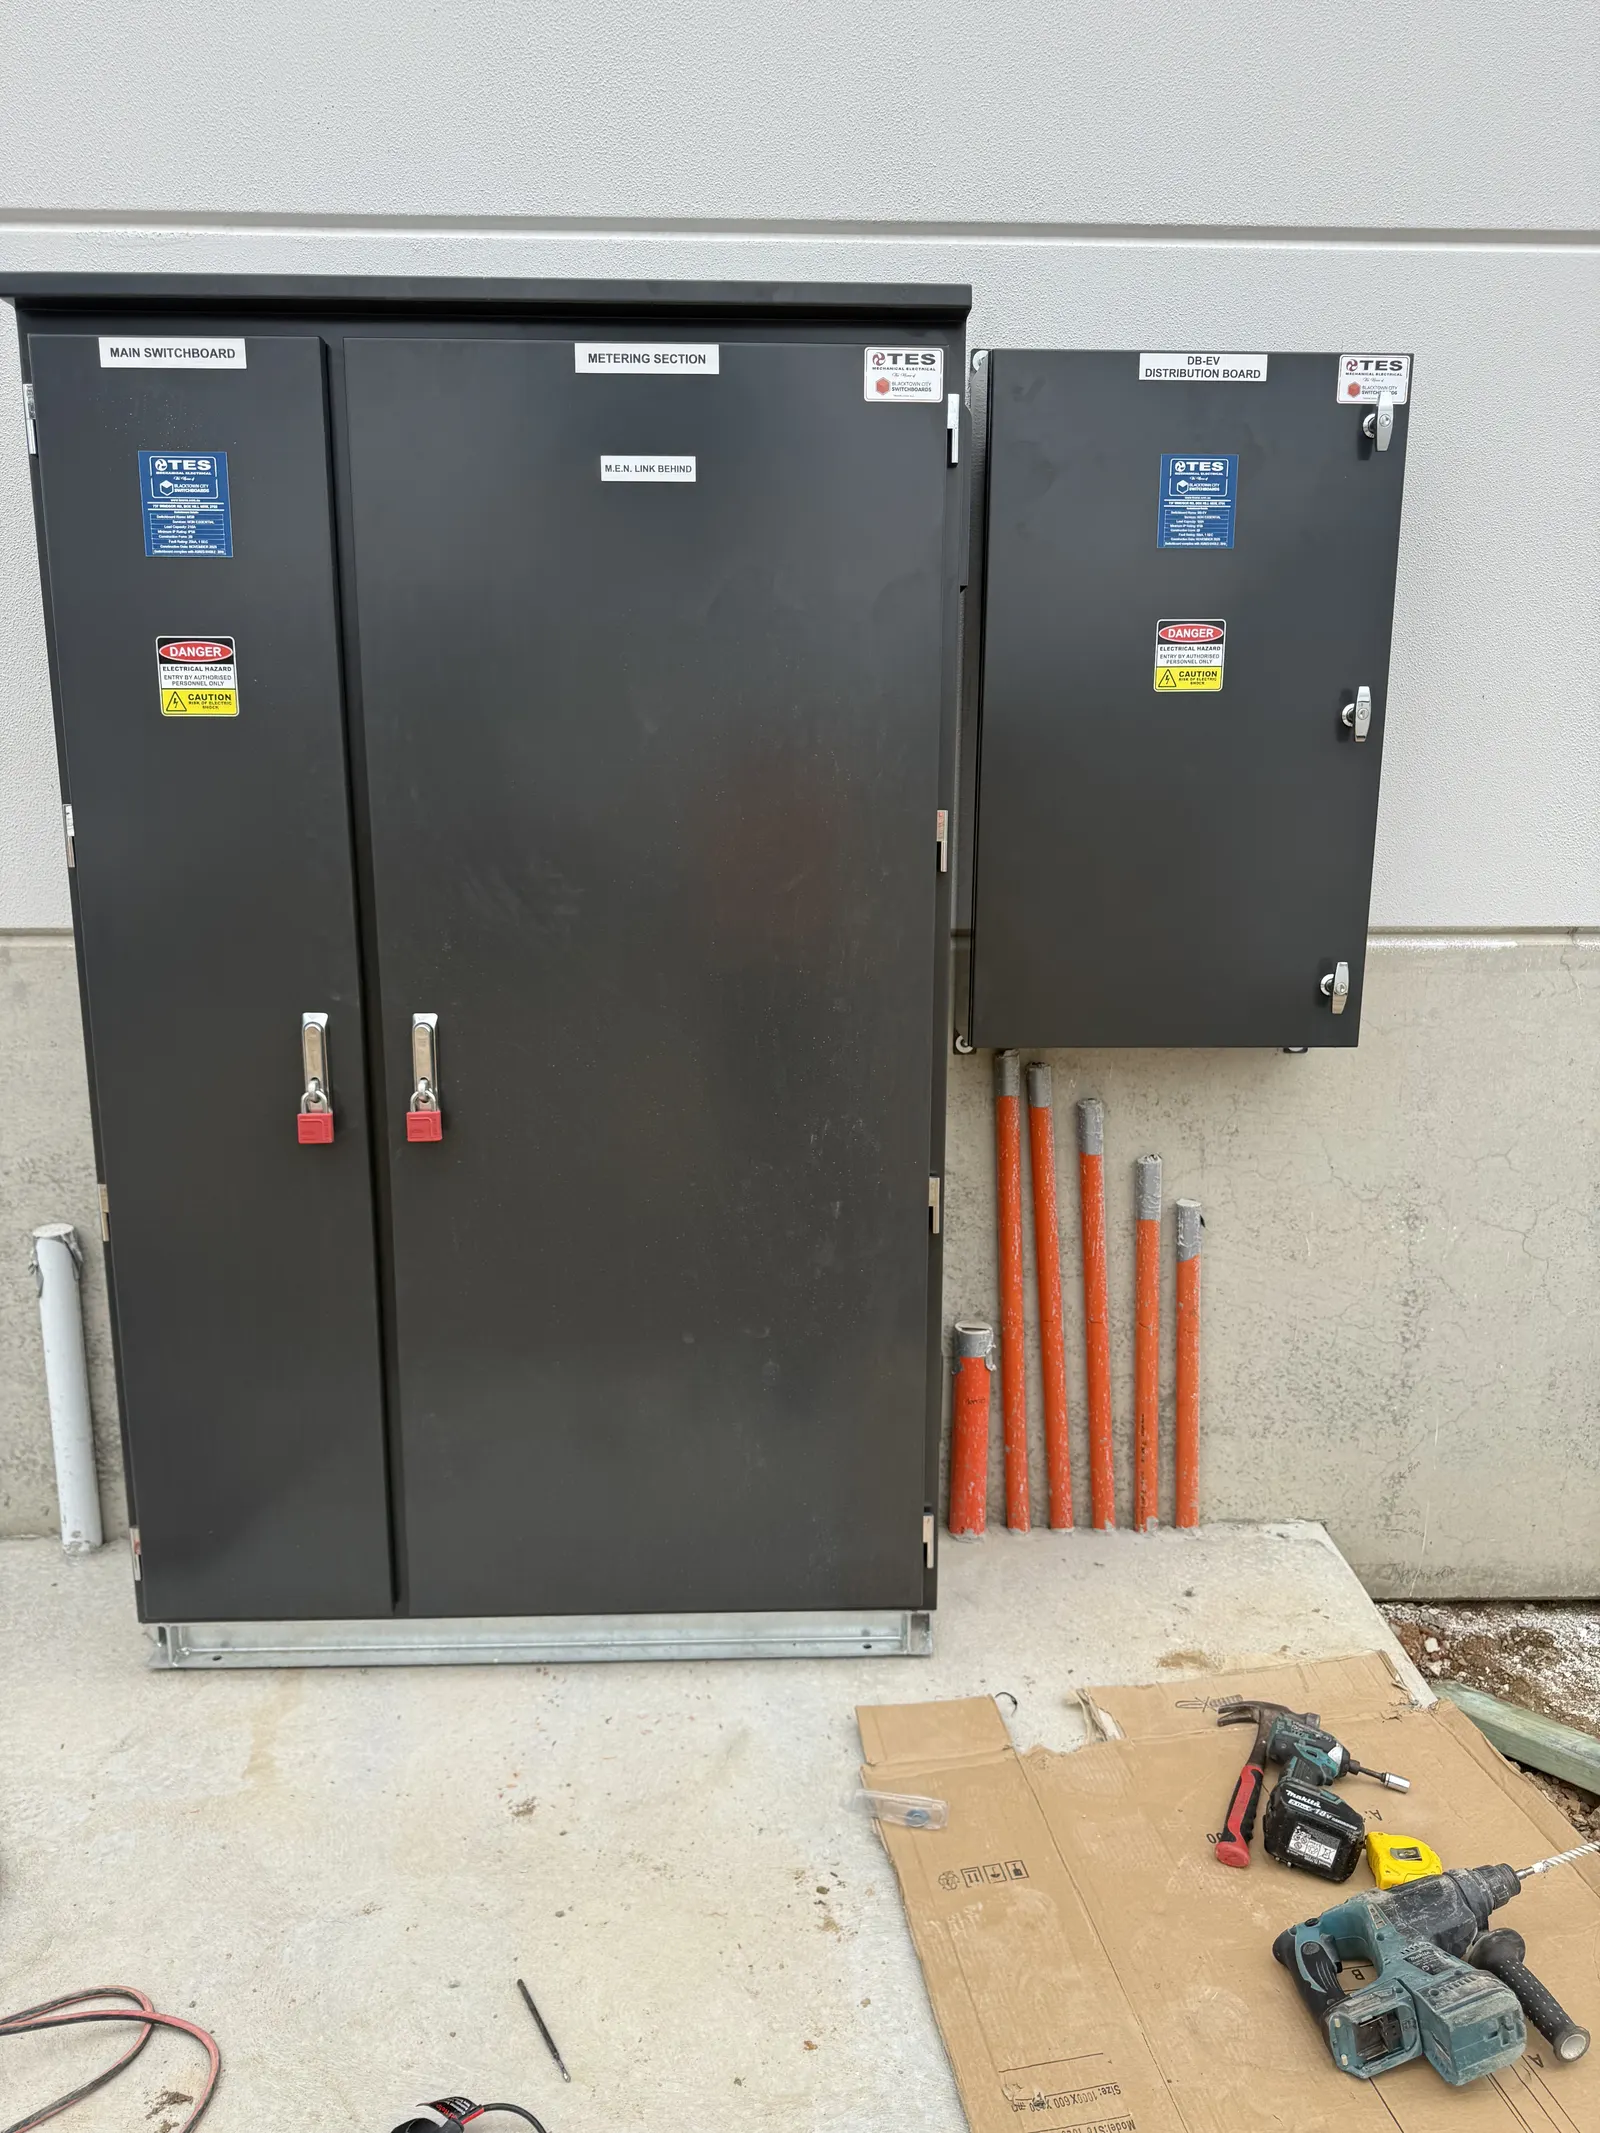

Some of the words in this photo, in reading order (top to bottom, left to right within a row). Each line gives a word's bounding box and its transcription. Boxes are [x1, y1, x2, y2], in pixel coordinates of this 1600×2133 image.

[110, 346, 141, 359] MAIN
[143, 347, 236, 360] SWITCHBOARD
[588, 353, 650, 364] METERING
[653, 354, 707, 365] SECTION
[887, 353, 936, 365] TES
[1187, 356, 1220, 365] DB-EV
[1360, 360, 1403, 371] TES
[1145, 368, 1219, 378] DISTRIBUTION
[1223, 369, 1261, 379] BOARD
[167, 460, 212, 471] TES
[605, 464, 632, 473] M.E.N.
[635, 465, 656, 473] LINK
[658, 465, 692, 473] BEHIND
[1186, 462, 1224, 471] TES
[1168, 629, 1214, 638] DANGER
[170, 647, 222, 657] DANGER
[1099, 2084, 1121, 2096] Size:
